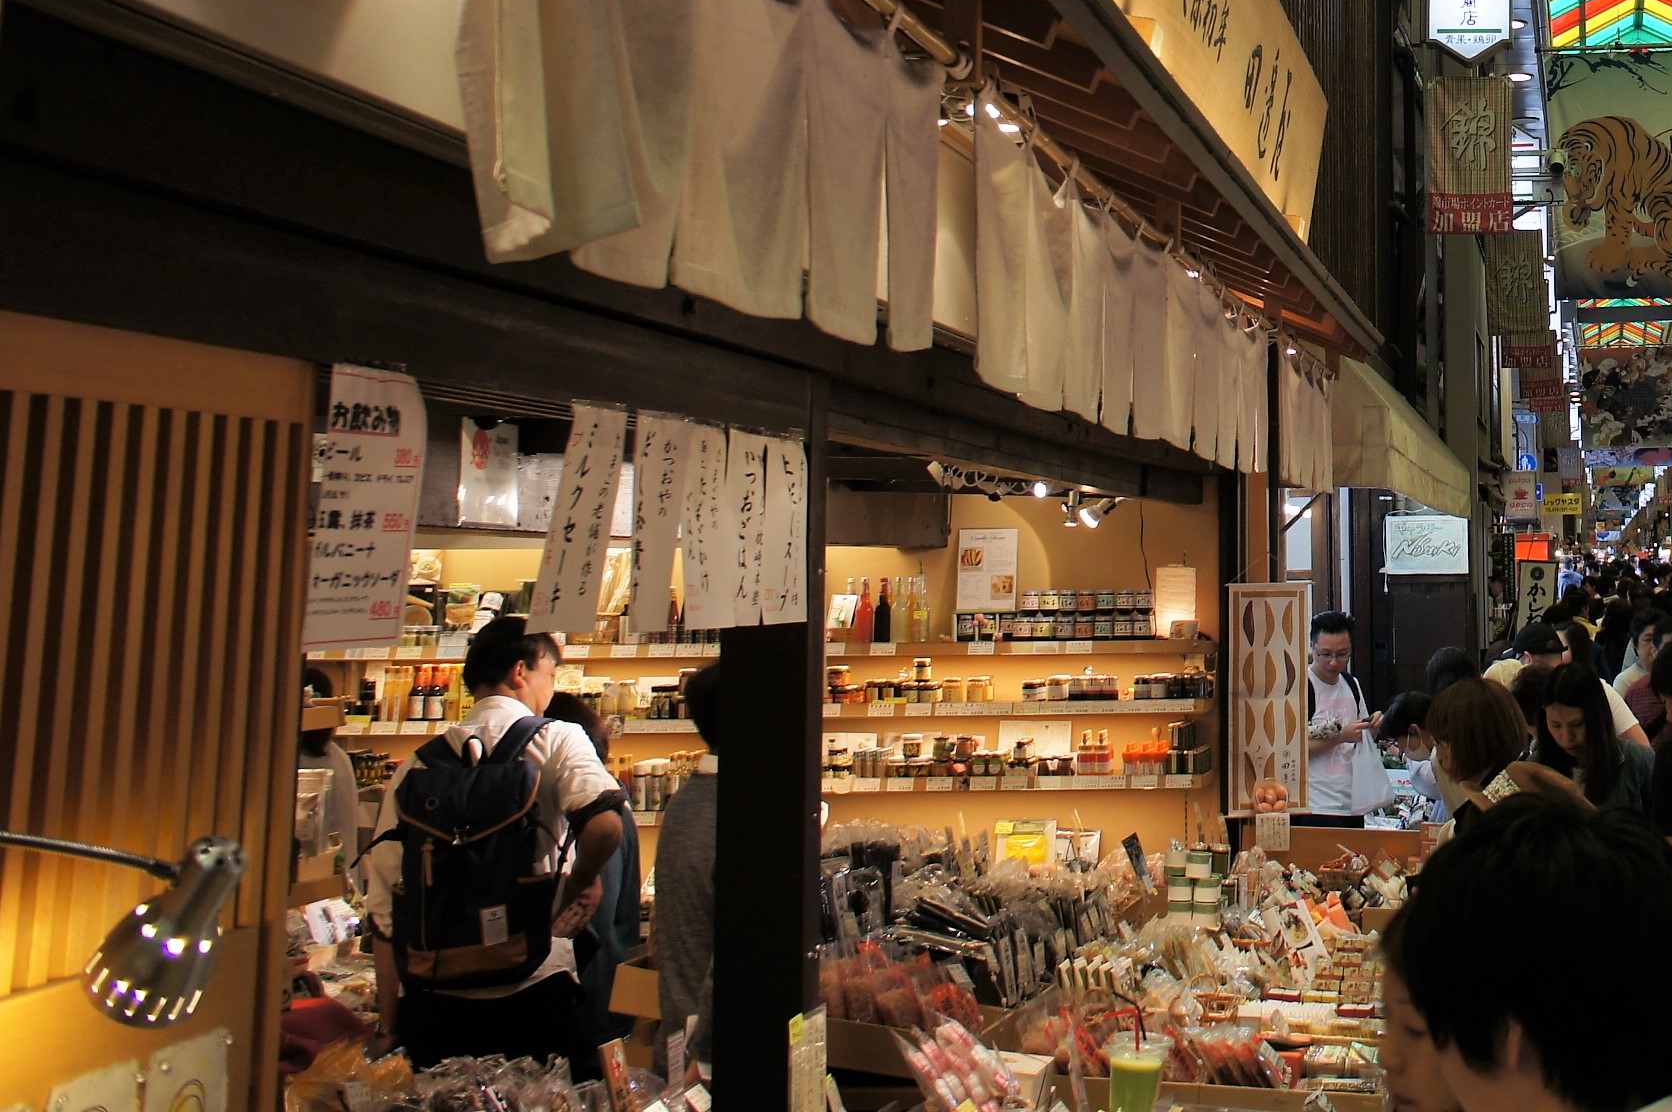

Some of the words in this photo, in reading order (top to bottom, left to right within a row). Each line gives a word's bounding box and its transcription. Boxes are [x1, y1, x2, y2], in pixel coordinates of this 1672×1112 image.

[1440, 97, 1496, 170] 錦
[1432, 195, 1510, 209] 錦市場ポイントカード
[1432, 209, 1510, 232] 加盟店
[549, 422, 601, 615] ミルクセーキ
